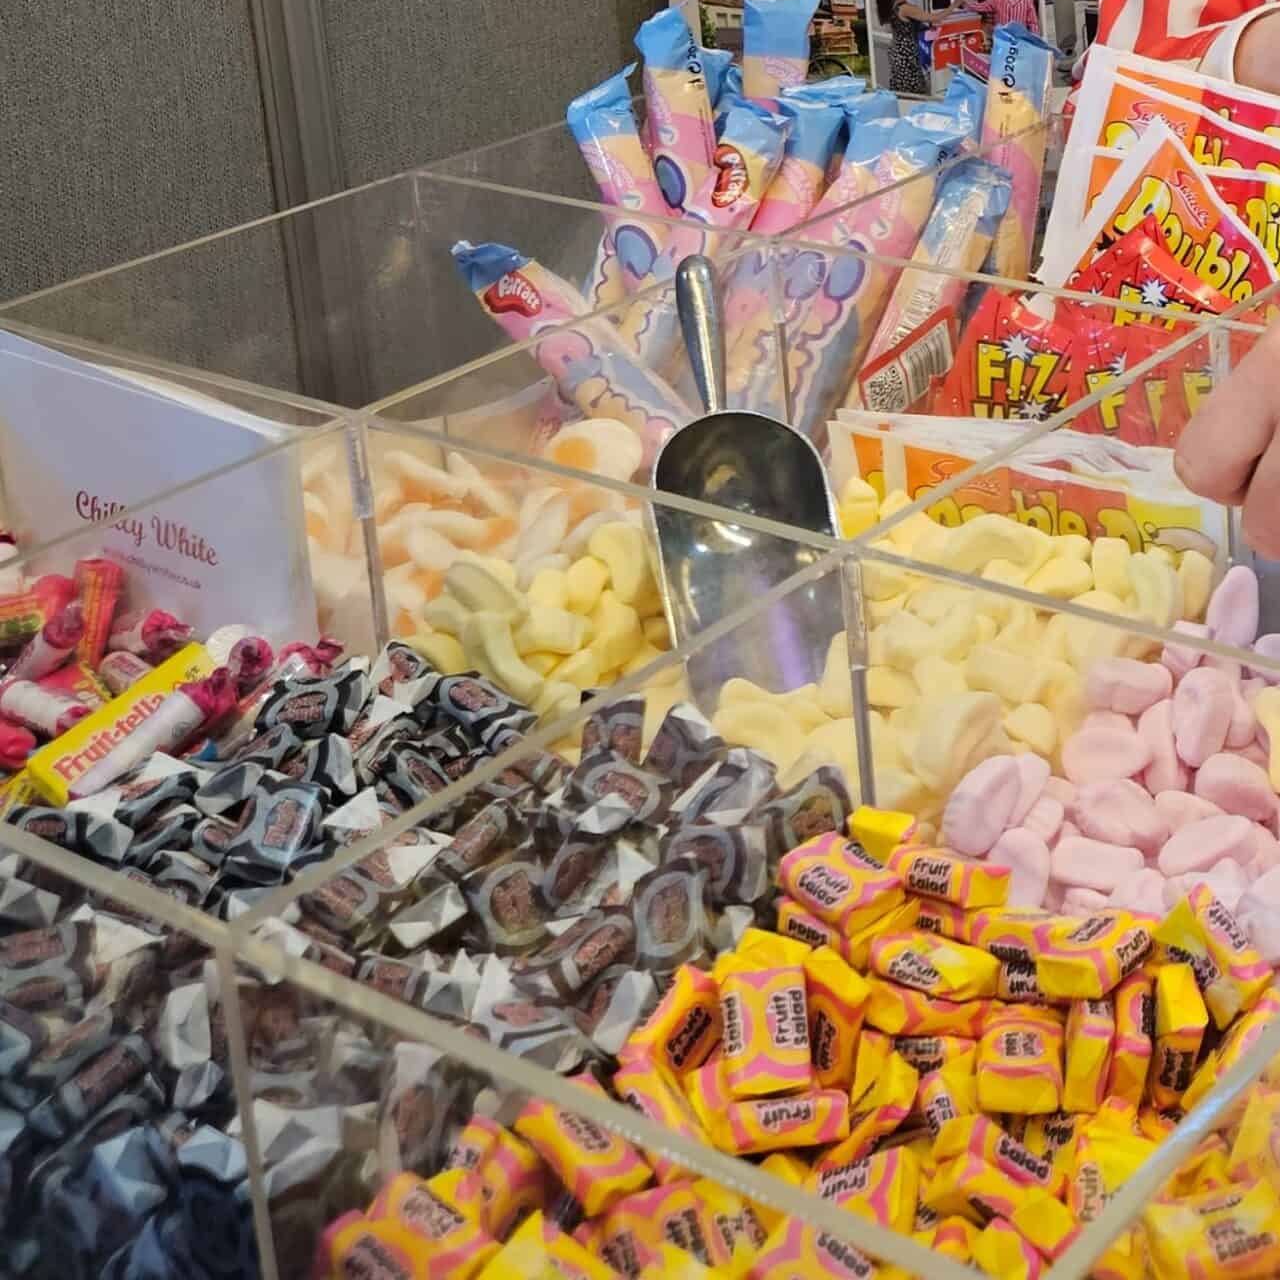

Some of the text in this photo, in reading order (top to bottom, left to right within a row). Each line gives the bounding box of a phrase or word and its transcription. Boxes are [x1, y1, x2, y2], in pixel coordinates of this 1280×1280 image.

[151, 515, 219, 566] White
[811, 864, 849, 894] Fruit
[907, 874, 948, 894] Salad
[912, 857, 951, 877] Fruit
[797, 874, 838, 908] Salad
[788, 918, 828, 946] Salad
[1208, 899, 1248, 951] Fruit
[723, 995, 742, 1055] Salad
[775, 993, 791, 1045] Fruit
[793, 989, 808, 1047] Salad
[761, 1104, 812, 1131] Fruit
[999, 1135, 1049, 1179] Salad
